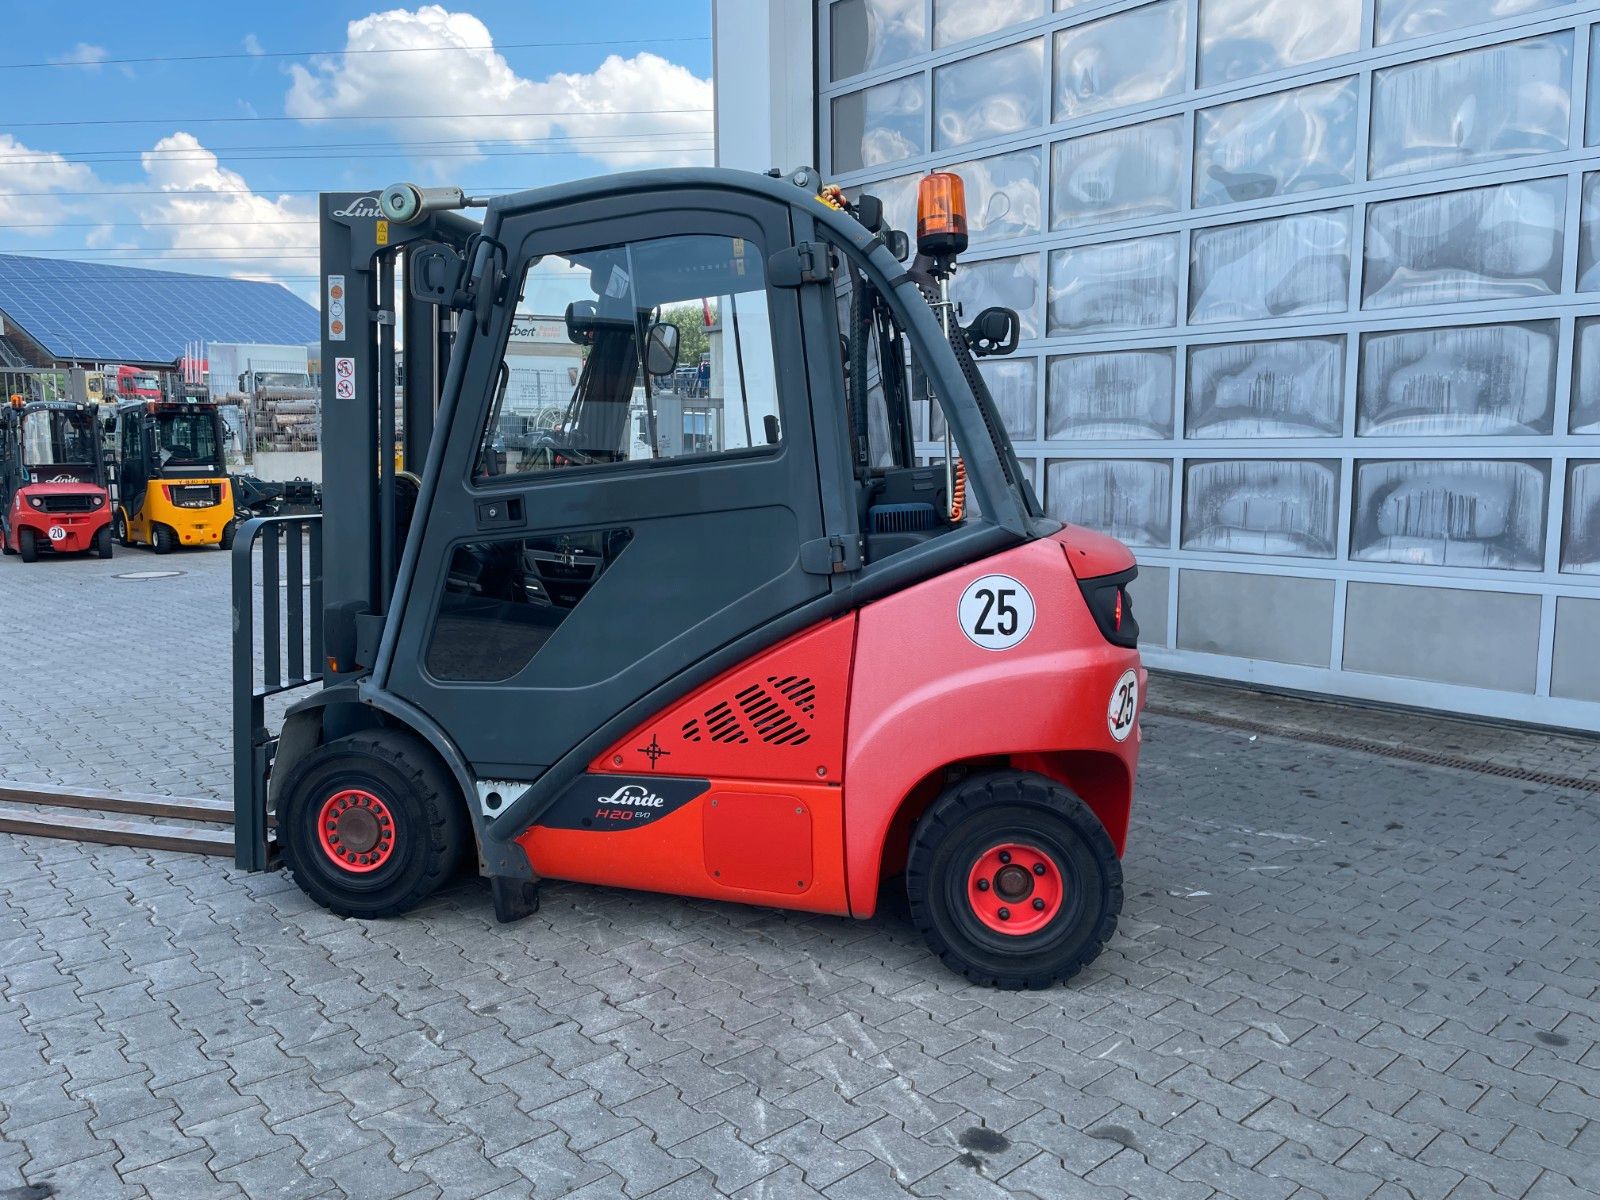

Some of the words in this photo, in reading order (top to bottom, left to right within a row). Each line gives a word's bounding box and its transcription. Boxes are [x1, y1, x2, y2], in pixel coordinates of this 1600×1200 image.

[51, 528, 63, 539] 20
[974, 588, 1018, 636] 25
[1115, 681, 1135, 730] 25
[597, 784, 664, 808] Linde
[595, 808, 633, 820] H20
[634, 811, 651, 819] EVO
